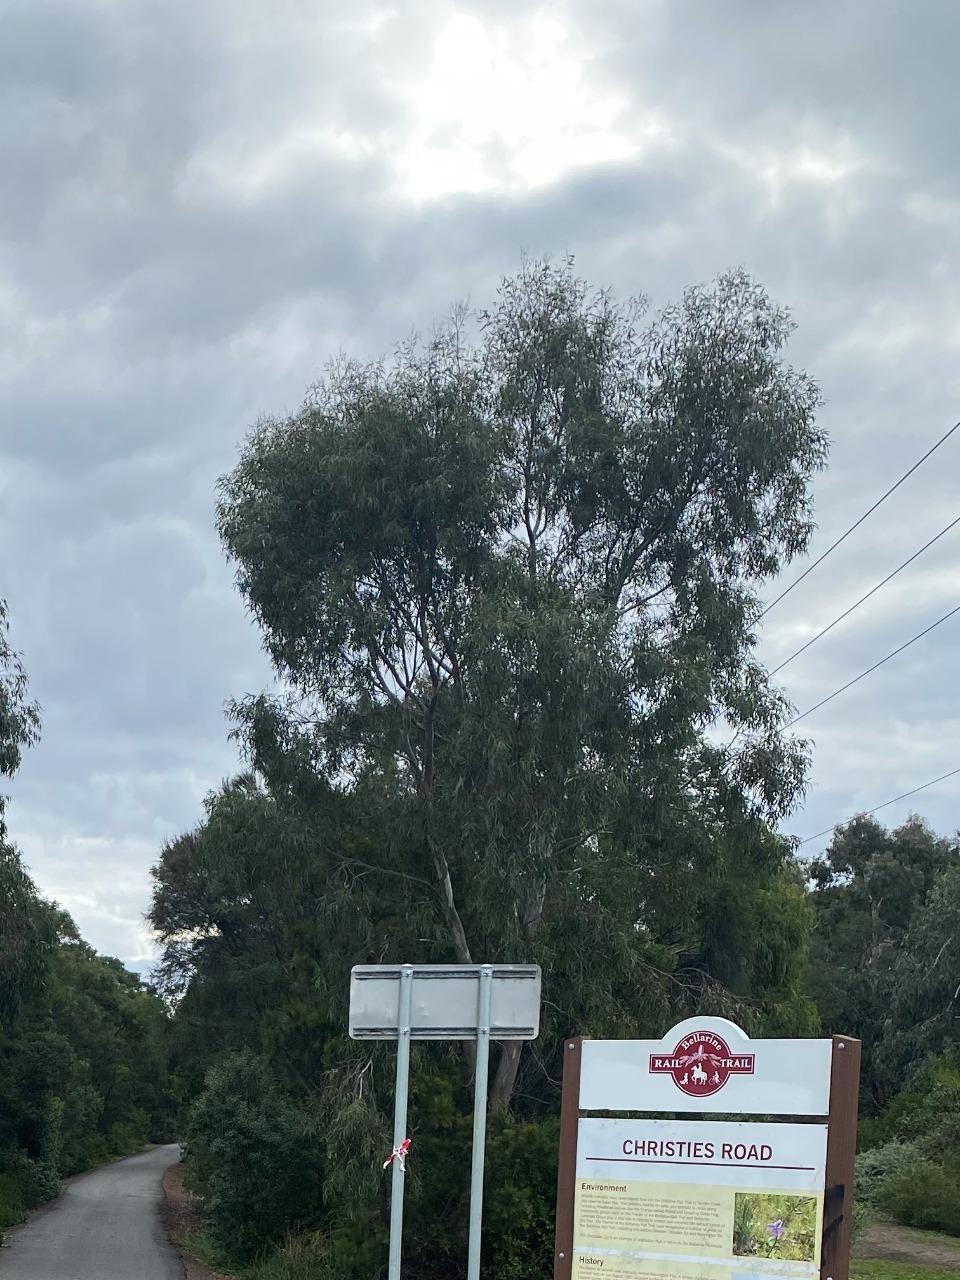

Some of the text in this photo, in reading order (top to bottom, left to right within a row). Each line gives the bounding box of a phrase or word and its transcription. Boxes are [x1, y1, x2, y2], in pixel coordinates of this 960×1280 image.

[681, 1034, 722, 1051] Bellarine
[655, 1059, 751, 1068] RAIL TRAIL
[622, 1140, 773, 1161] CHRISTIES ROAD
[581, 1182, 627, 1193] Environment
[579, 1256, 605, 1267] History
